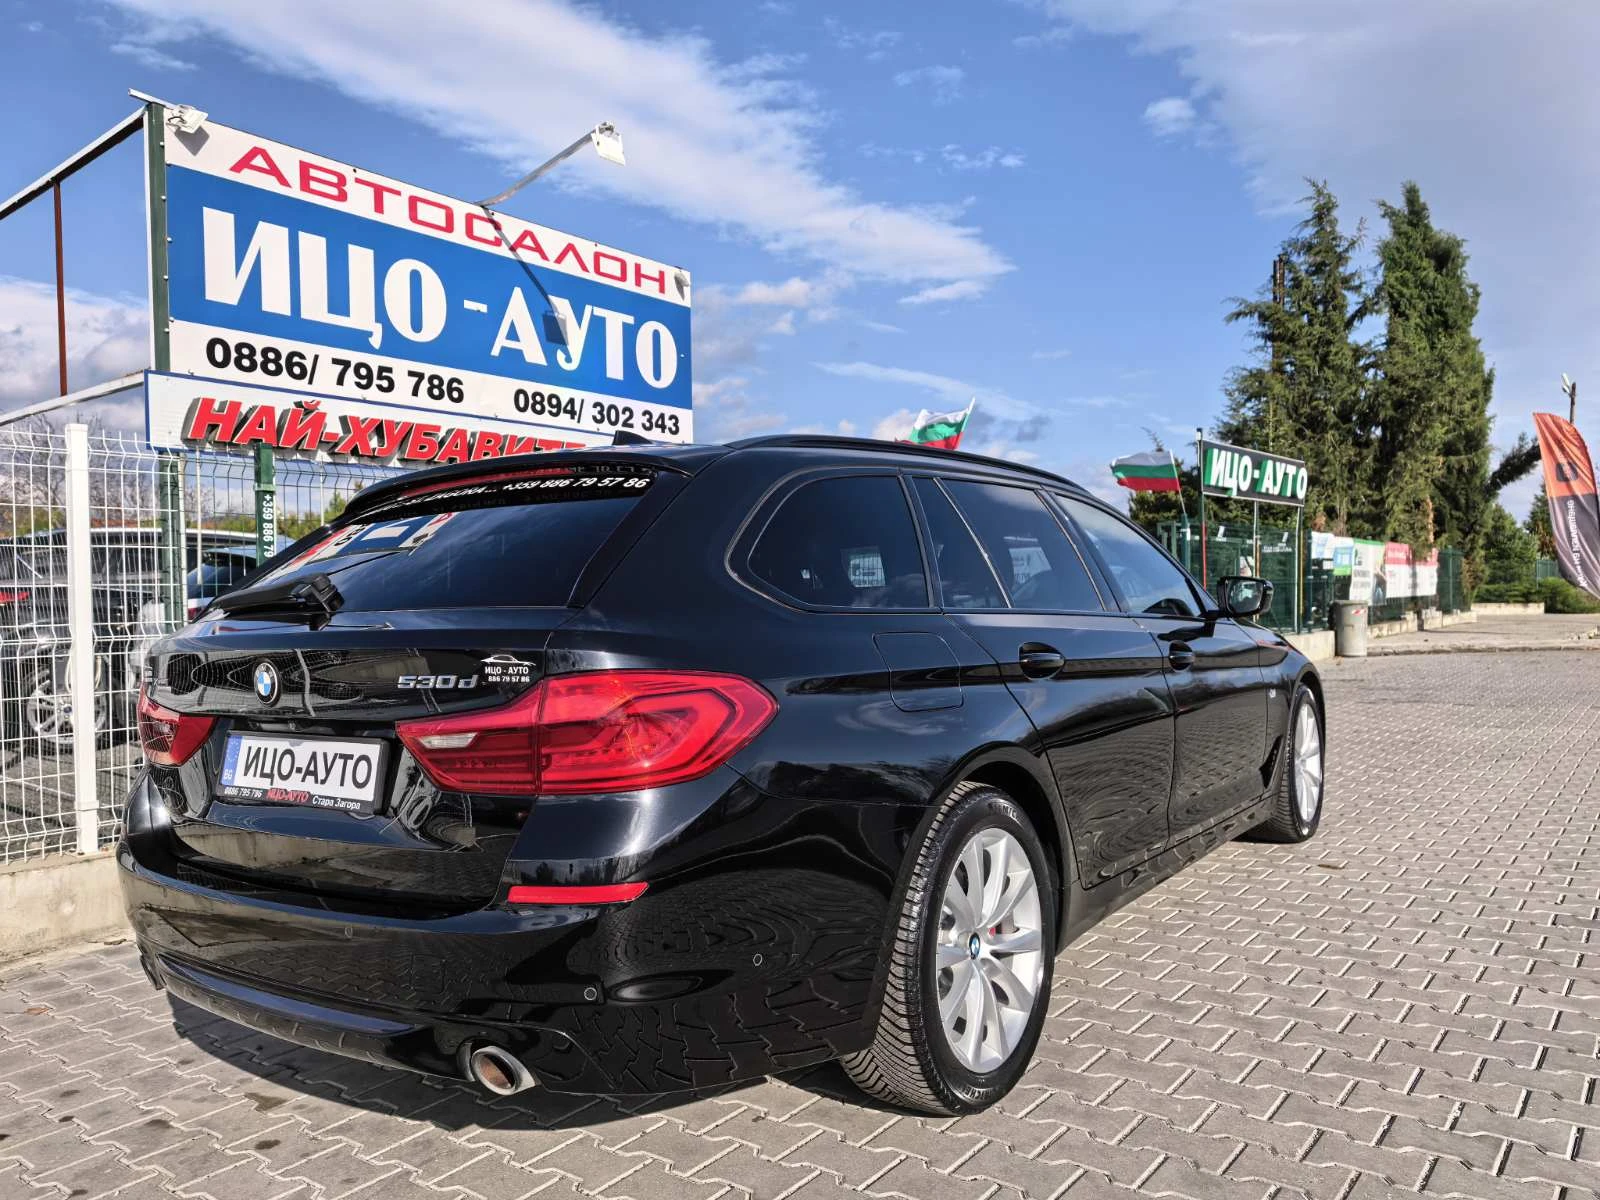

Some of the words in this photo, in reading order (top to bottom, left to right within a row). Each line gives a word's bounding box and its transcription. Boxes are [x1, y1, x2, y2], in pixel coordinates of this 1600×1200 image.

[229, 146, 665, 294] АВТОСАЛОН
[206, 337, 319, 385] 0886/
[331, 357, 395, 393] 795
[407, 369, 464, 403] 786
[514, 388, 584, 424] 0894/
[592, 401, 634, 429] 302
[641, 409, 680, 435] 343
[540, 478, 575, 488] 886
[572, 477, 598, 488] 79
[597, 477, 625, 487] 57
[623, 477, 650, 488] 86
[1207, 448, 1308, 500] ИЦО-АУТО
[262, 494, 273, 520] +359
[262, 522, 274, 542] 886
[263, 544, 274, 558] 79
[397, 674, 479, 689] 530d
[484, 666, 502, 675] ИЦО
[508, 666, 529, 675] АУТО
[243, 745, 373, 790] ИЦО-АУТО
[312, 795, 335, 807] Стара
[335, 797, 361, 811] Загора
